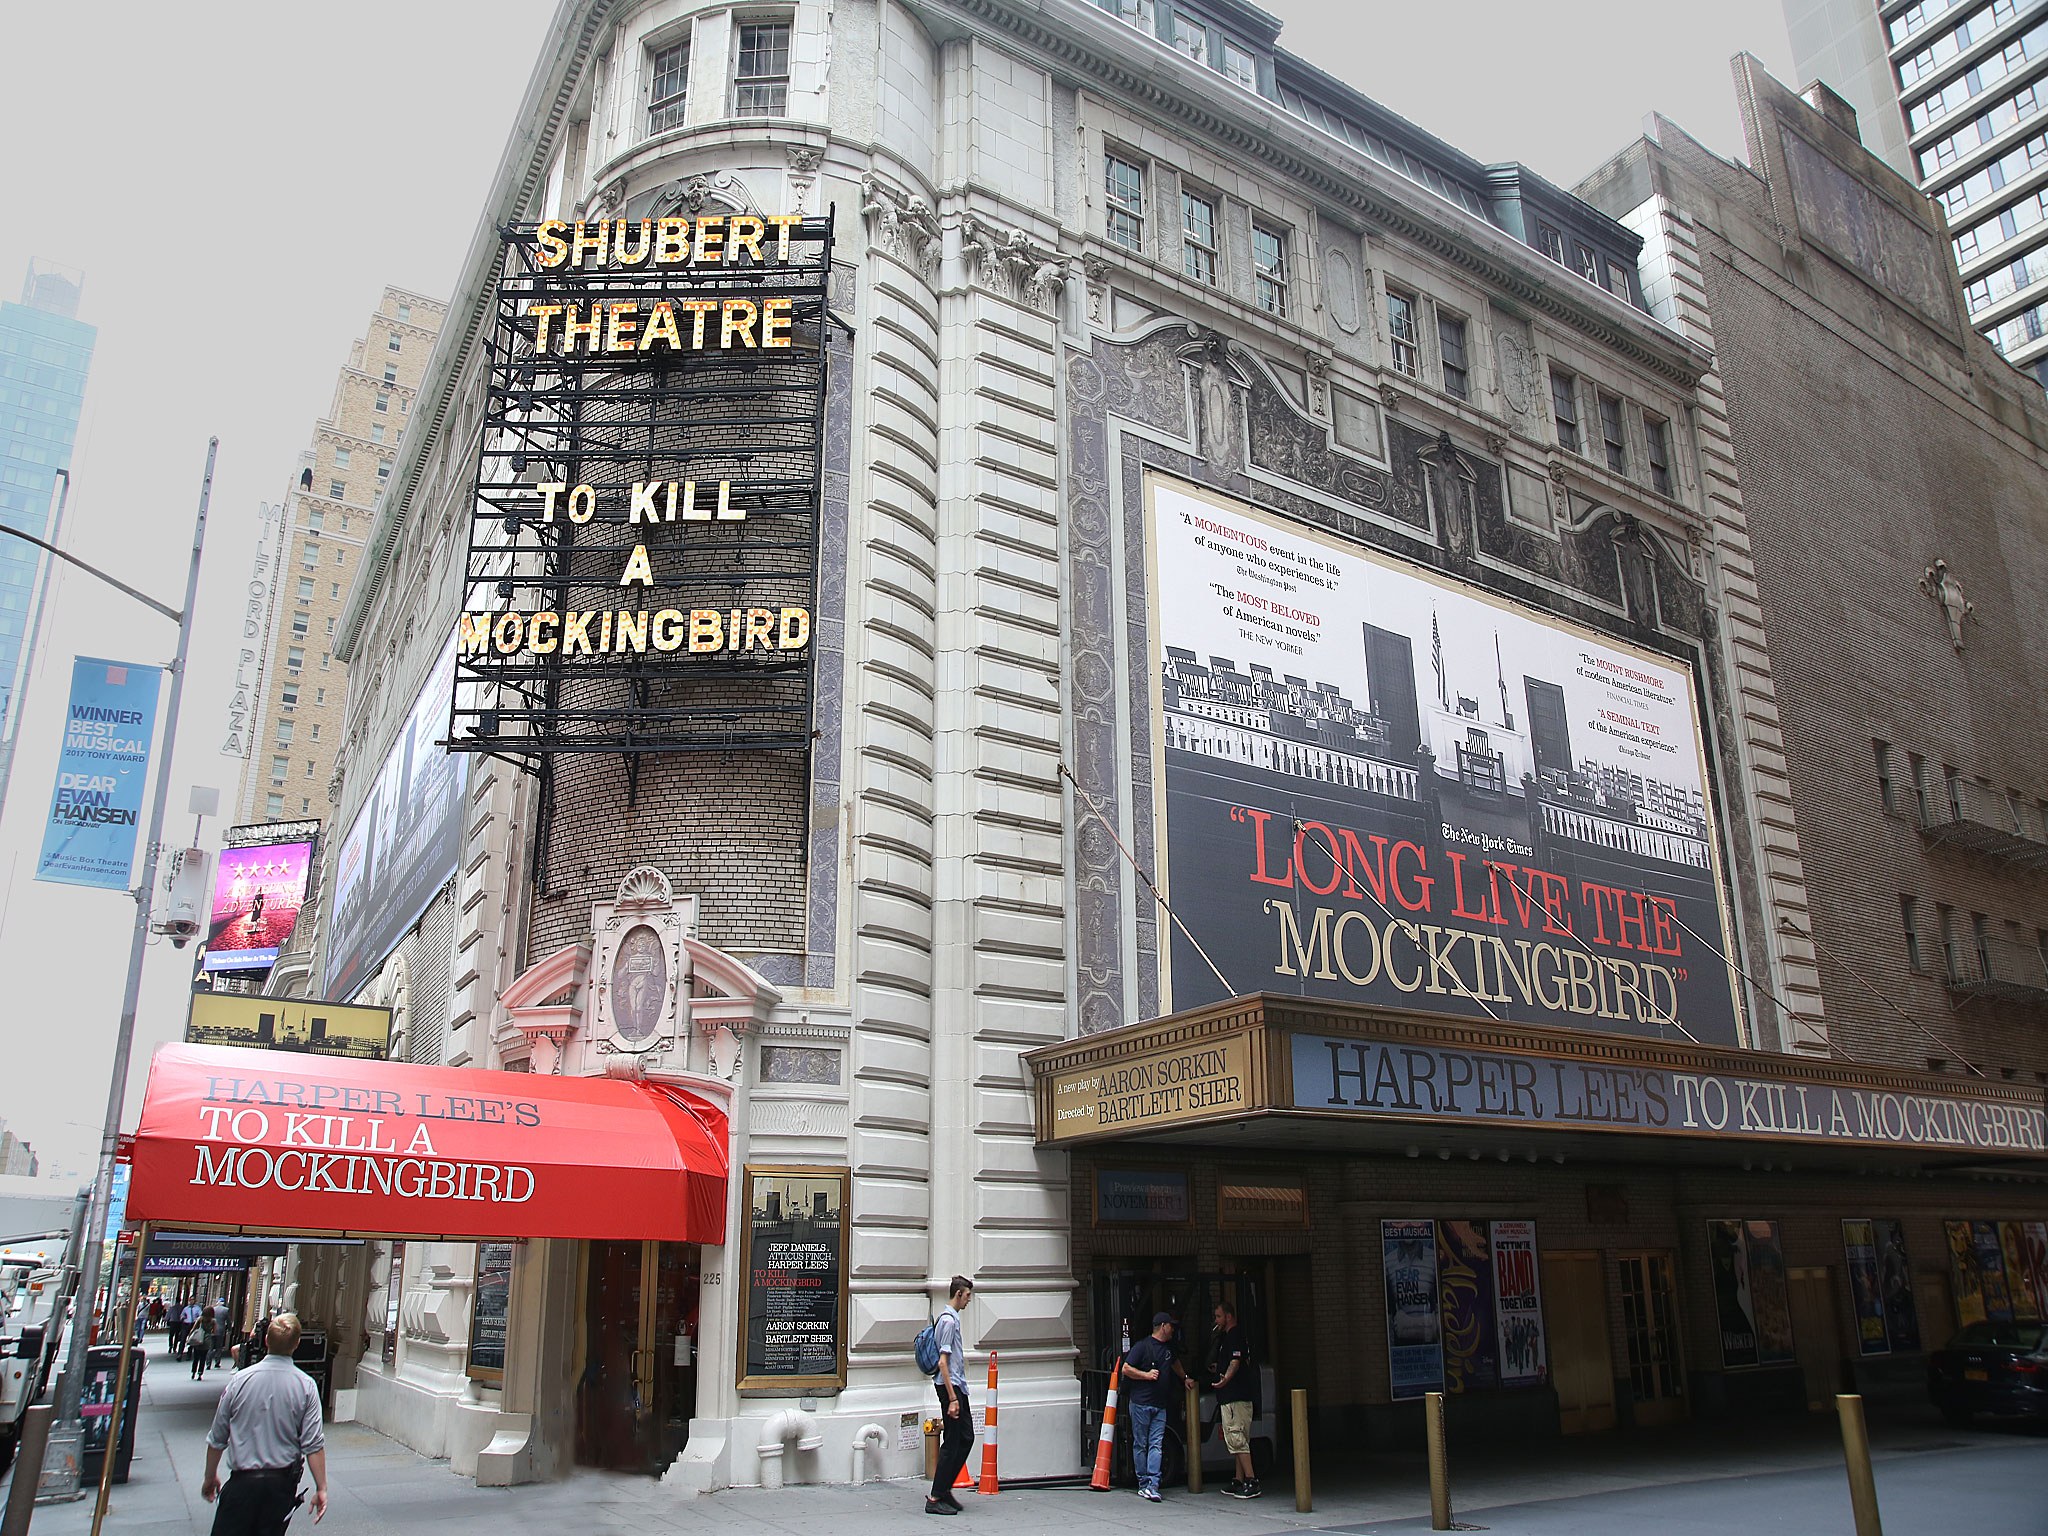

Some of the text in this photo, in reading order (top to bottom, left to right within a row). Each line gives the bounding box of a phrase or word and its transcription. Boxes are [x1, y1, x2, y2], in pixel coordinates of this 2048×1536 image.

[534, 216, 803, 268] SHUBERT
[528, 298, 793, 354] THEATRE
[537, 480, 747, 524] TO KILL
[1194, 516, 1268, 551] MOMENTOUS
[1269, 546, 1295, 562] event
[1297, 552, 1307, 565] in
[1308, 555, 1324, 571] the
[1325, 560, 1341, 577] life
[620, 544, 654, 586] A
[1194, 534, 1206, 547] of
[1207, 539, 1244, 562] anyone
[1246, 551, 1266, 567] who
[1268, 561, 1325, 588] experiences
[1223, 604, 1233, 616] of
[1235, 608, 1284, 633] American
[1270, 601, 1321, 627] BELOVED
[222, 501, 288, 754] MILFORD PLAZA
[458, 608, 811, 655] MOCKINGBIRD
[1238, 628, 1304, 656] THE NEW YORKER
[1576, 666, 1584, 676] of
[1584, 669, 1611, 685] modern
[1611, 677, 1643, 696] American
[1596, 658, 1624, 676] MOUNT
[1624, 668, 1665, 690] RUSHMORE
[1606, 691, 1649, 711] FINANCIAL TIMES
[72, 704, 144, 725] WINNER
[1606, 710, 1641, 729] SEMINAL
[1640, 721, 1660, 736] TEXT
[68, 719, 118, 737] BEST
[1588, 720, 1596, 730] of
[1596, 721, 1608, 732] the
[1608, 725, 1641, 744] American
[66, 733, 146, 754] MUSICAL
[66, 749, 146, 763] 2017 TONY AWARD
[60, 772, 117, 793] DEAR
[57, 787, 111, 807] EVAN
[53, 803, 137, 826] HANSEN
[1441, 822, 1533, 858] The New York Times
[44, 860, 127, 876] DearEvanHansen.com
[98, 858, 128, 868] Theatre
[1445, 850, 1573, 938] LIVE
[1581, 881, 1683, 957] THE
[1057, 1048, 1227, 1098] A new play by AARON SORKIN
[205, 1076, 542, 1128] HARPER LEE'S
[1057, 1076, 1242, 1125] Directed by BARTLETT SHER
[1324, 1041, 2048, 1151] HARPER LEE'S TO KILL A MOCKINGBIRD
[199, 1105, 438, 1156] TO KILL A
[189, 1145, 535, 1204] MOCKINGBIRD
[1103, 1193, 1173, 1210] NOVEMBER
[1225, 1196, 1290, 1212] DECEMBER
[1385, 1226, 1432, 1237] BEST MUSICAL
[768, 1243, 826, 1252] JEFF DANIELS
[768, 1252, 832, 1261] ATTICUS FINCH
[158, 1256, 212, 1267] SERIOUS
[214, 1258, 240, 1267] HIT!
[767, 1260, 803, 1269] HARPER
[703, 1273, 721, 1285] 225
[753, 1269, 788, 1278] TO KILL
[753, 1278, 822, 1287] A MOCKINGBIRD
[1395, 1268, 1419, 1282] DEAR
[1496, 1250, 1535, 1297] BAND
[1396, 1281, 1419, 1294] EVAN
[1396, 1293, 1432, 1306] HANSEN
[1500, 1296, 1538, 1310] TOGETHER
[765, 1321, 829, 1331] AARON SORKIN
[765, 1334, 833, 1344] BARTLETT SHER
[1722, 1331, 1754, 1351] WICKED
